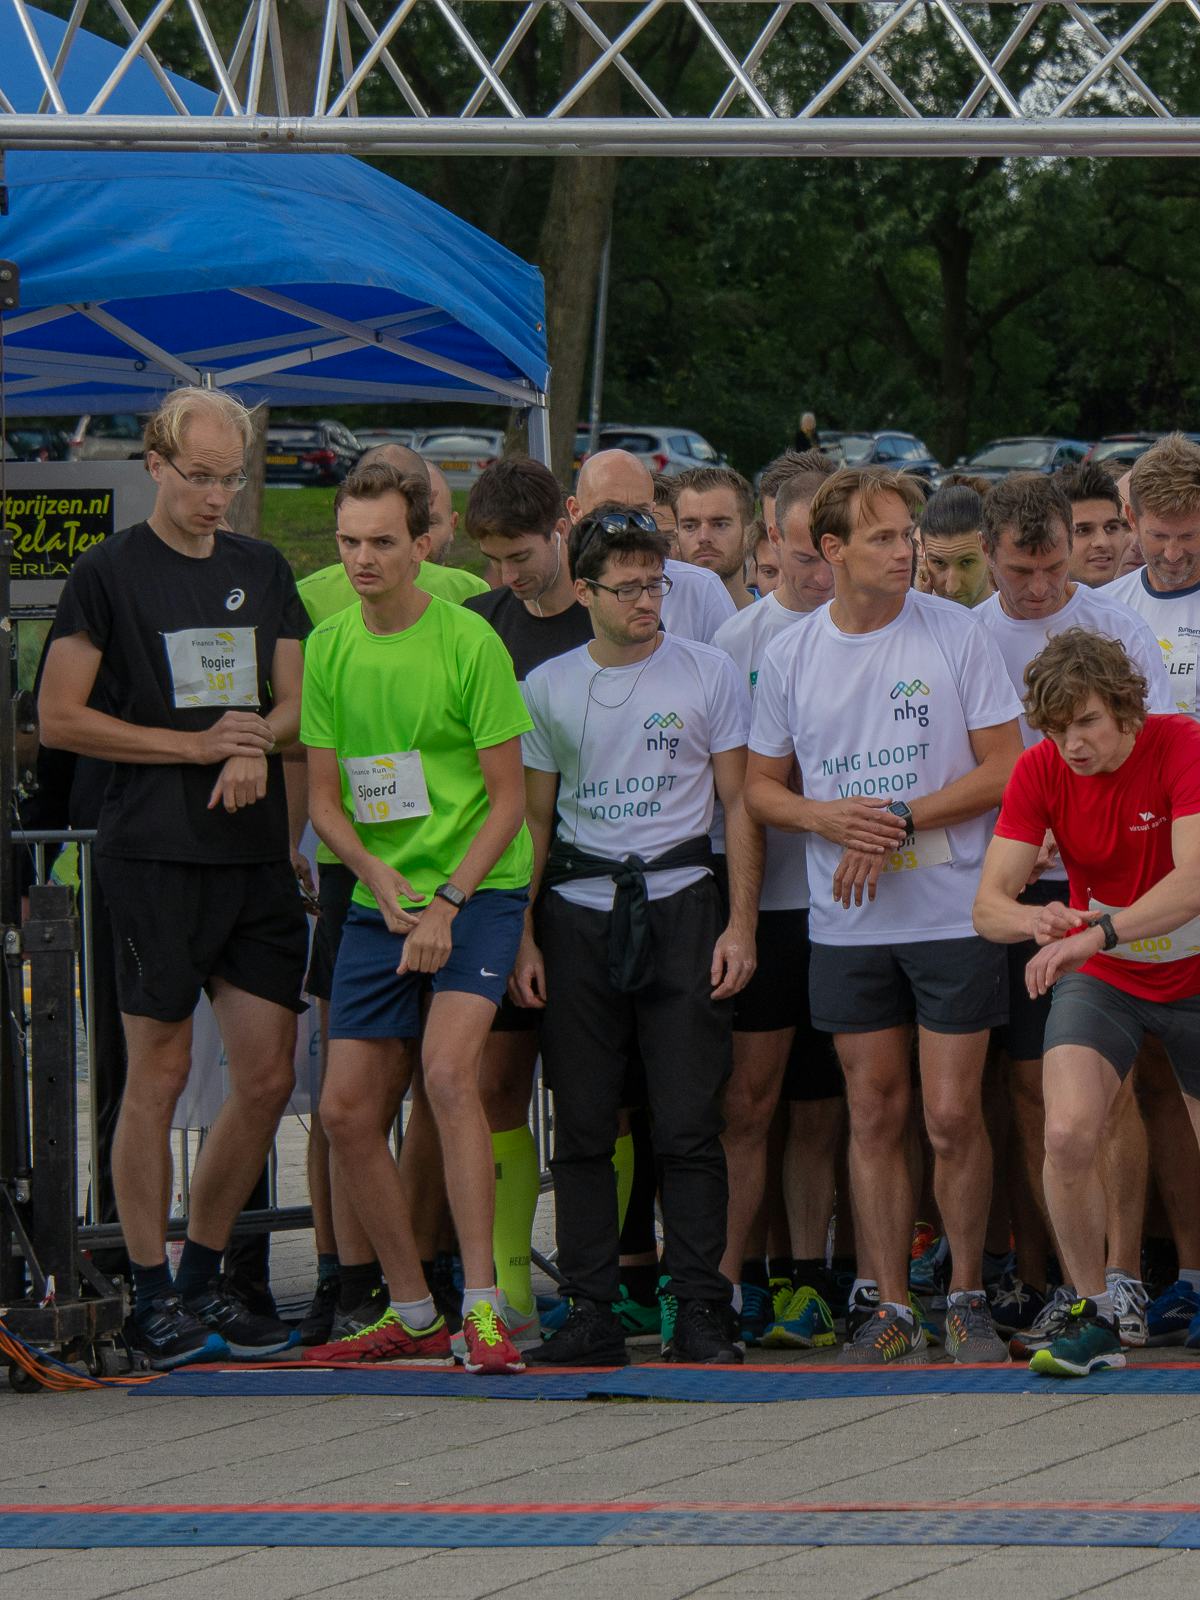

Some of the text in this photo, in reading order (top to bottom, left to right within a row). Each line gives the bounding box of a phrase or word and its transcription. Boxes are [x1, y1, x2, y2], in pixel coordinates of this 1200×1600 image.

[9, 563, 76, 576] ERLA
[201, 655, 236, 672] Rogier
[1169, 662, 1195, 675] LEF
[206, 672, 235, 691] 381
[894, 699, 930, 728] nhg
[646, 730, 680, 760] nhg
[822, 743, 930, 777] NHG LOOPT
[351, 767, 371, 776] inance
[357, 780, 398, 802] Sjoerd
[615, 775, 678, 796] LOOPT
[838, 772, 919, 800] VOOROP
[367, 801, 417, 820] 19 340
